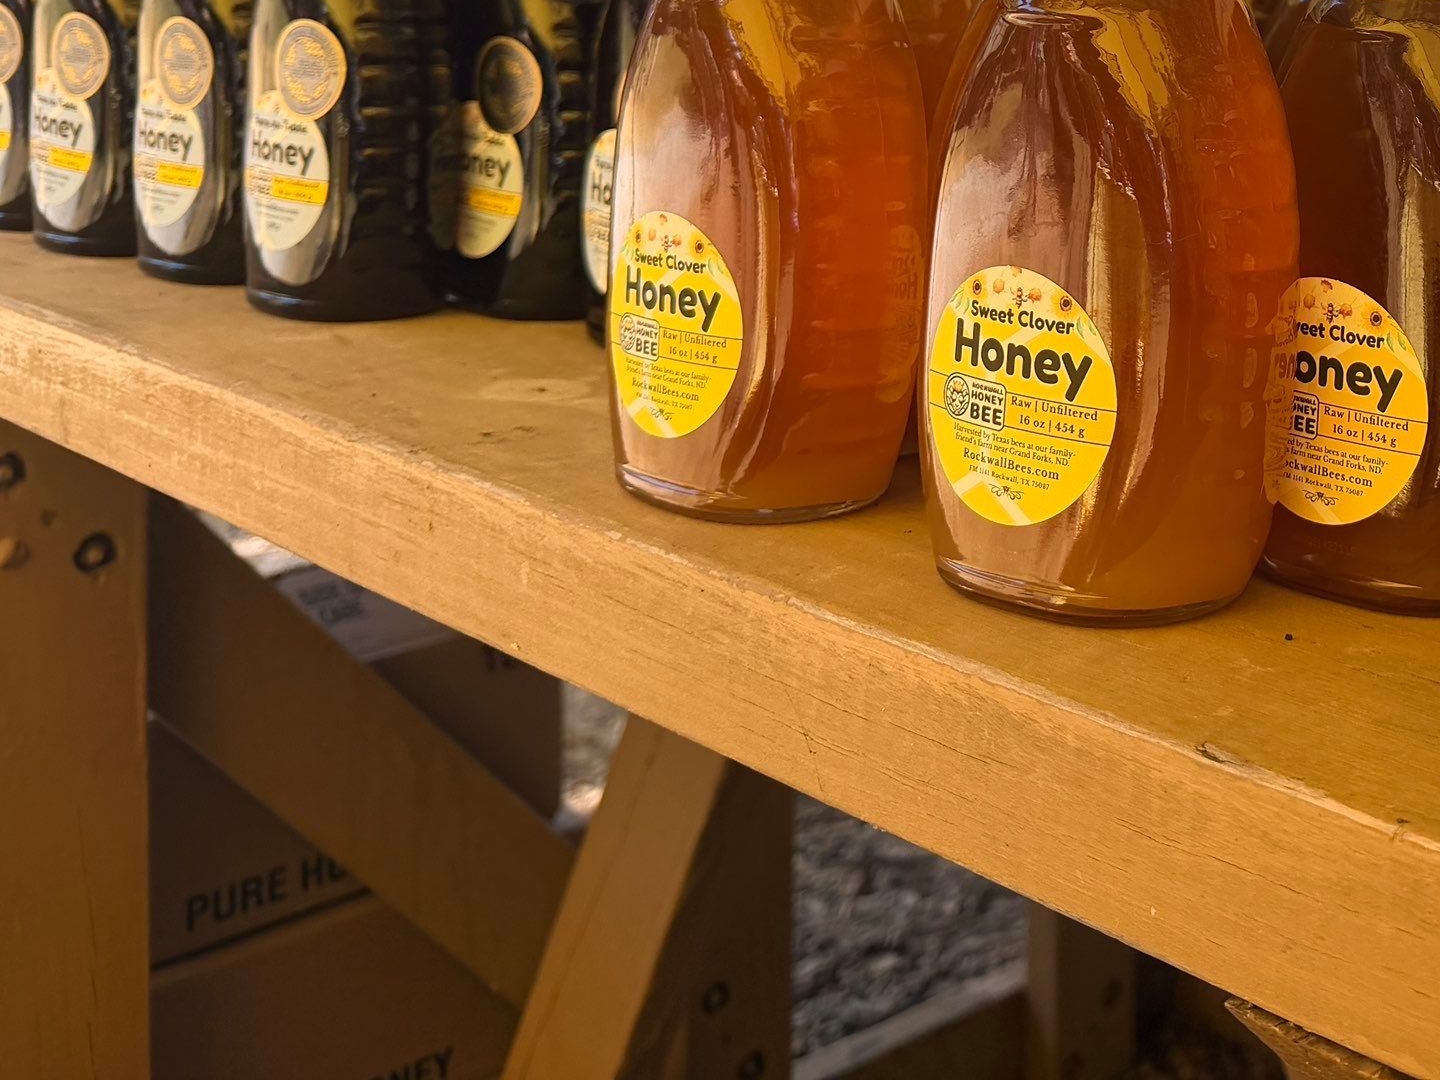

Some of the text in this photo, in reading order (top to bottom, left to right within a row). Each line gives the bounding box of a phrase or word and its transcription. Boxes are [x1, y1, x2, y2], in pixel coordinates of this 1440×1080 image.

[139, 120, 194, 162] Honey
[251, 129, 314, 177] Honey
[634, 248, 706, 274] Sweet Clover
[625, 265, 721, 332] Honey
[971, 299, 1074, 334] Sweet Clover
[635, 337, 657, 356] BEE
[663, 329, 727, 348] Raw Unfiltered
[1295, 321, 1384, 348] eet Clover
[954, 317, 1092, 402] Honey
[632, 377, 699, 401] RockwallBees.com
[972, 382, 1003, 395] ROCKWALL
[1294, 350, 1403, 413] oney
[971, 389, 1003, 406] HONEY
[1011, 395, 1097, 421] Raw Unfiltered
[970, 402, 1004, 427] BEE
[1019, 414, 1085, 438] 16 oz 454 g
[1294, 414, 1317, 436] EE
[1323, 405, 1408, 431] Raw Unfiltered
[991, 432, 1009, 444] Texas
[1010, 437, 1025, 448] bees
[1332, 423, 1397, 448] 16 oz 454 g
[1009, 446, 1030, 458] Grand
[1032, 451, 1053, 464] Forks,
[1304, 441, 1323, 452] Texas
[1324, 445, 1339, 456] bees
[963, 447, 1059, 480] RockwallBees.com
[1285, 459, 1373, 487] ckwallBees.com
[1322, 454, 1344, 466] Grand
[1345, 459, 1366, 472] Forks,
[185, 866, 288, 932] PURE
